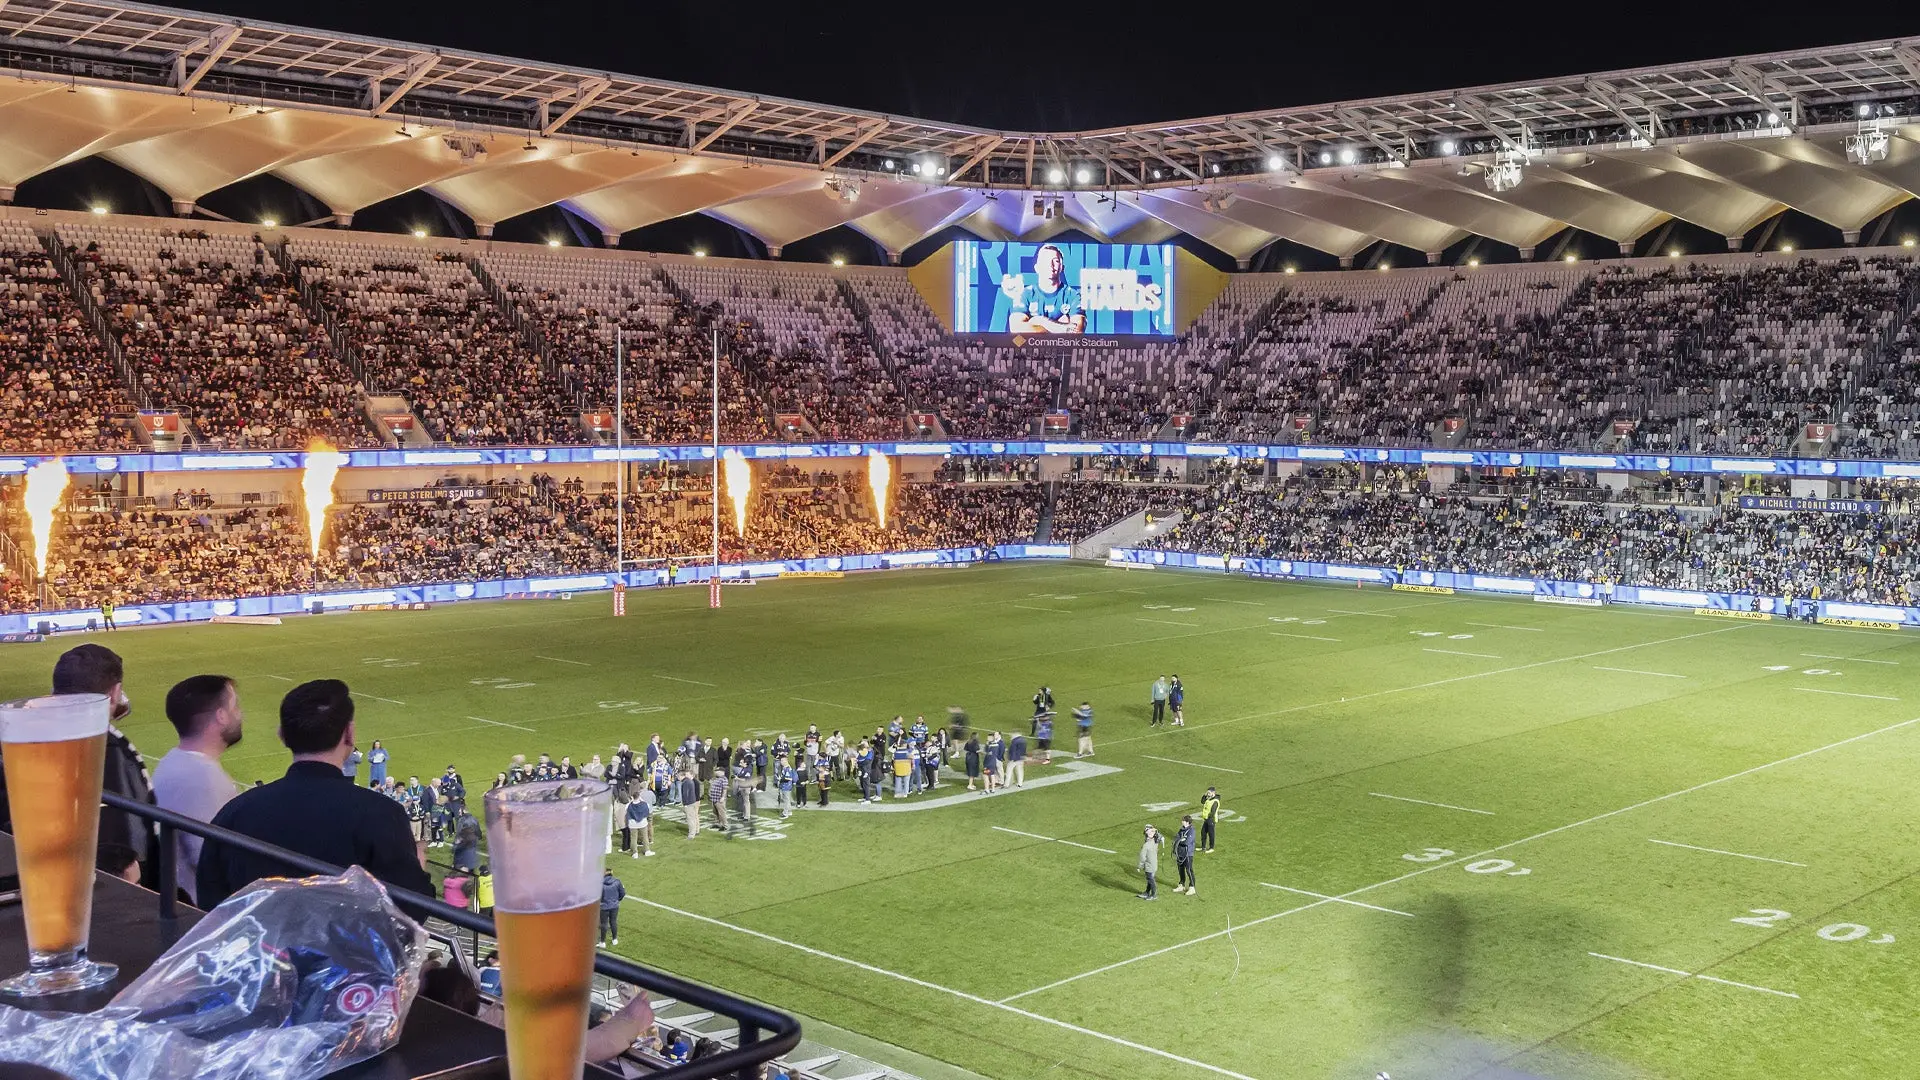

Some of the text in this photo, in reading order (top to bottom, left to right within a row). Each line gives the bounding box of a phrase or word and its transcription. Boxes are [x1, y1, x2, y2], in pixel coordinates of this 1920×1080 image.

[1028, 337, 1119, 347] CommBank Stadium
[382, 489, 474, 500] PETER STERLING STAND
[1759, 499, 1858, 511] MICHAEL CRONIN STAND
[1734, 611, 1763, 619] ALAND
